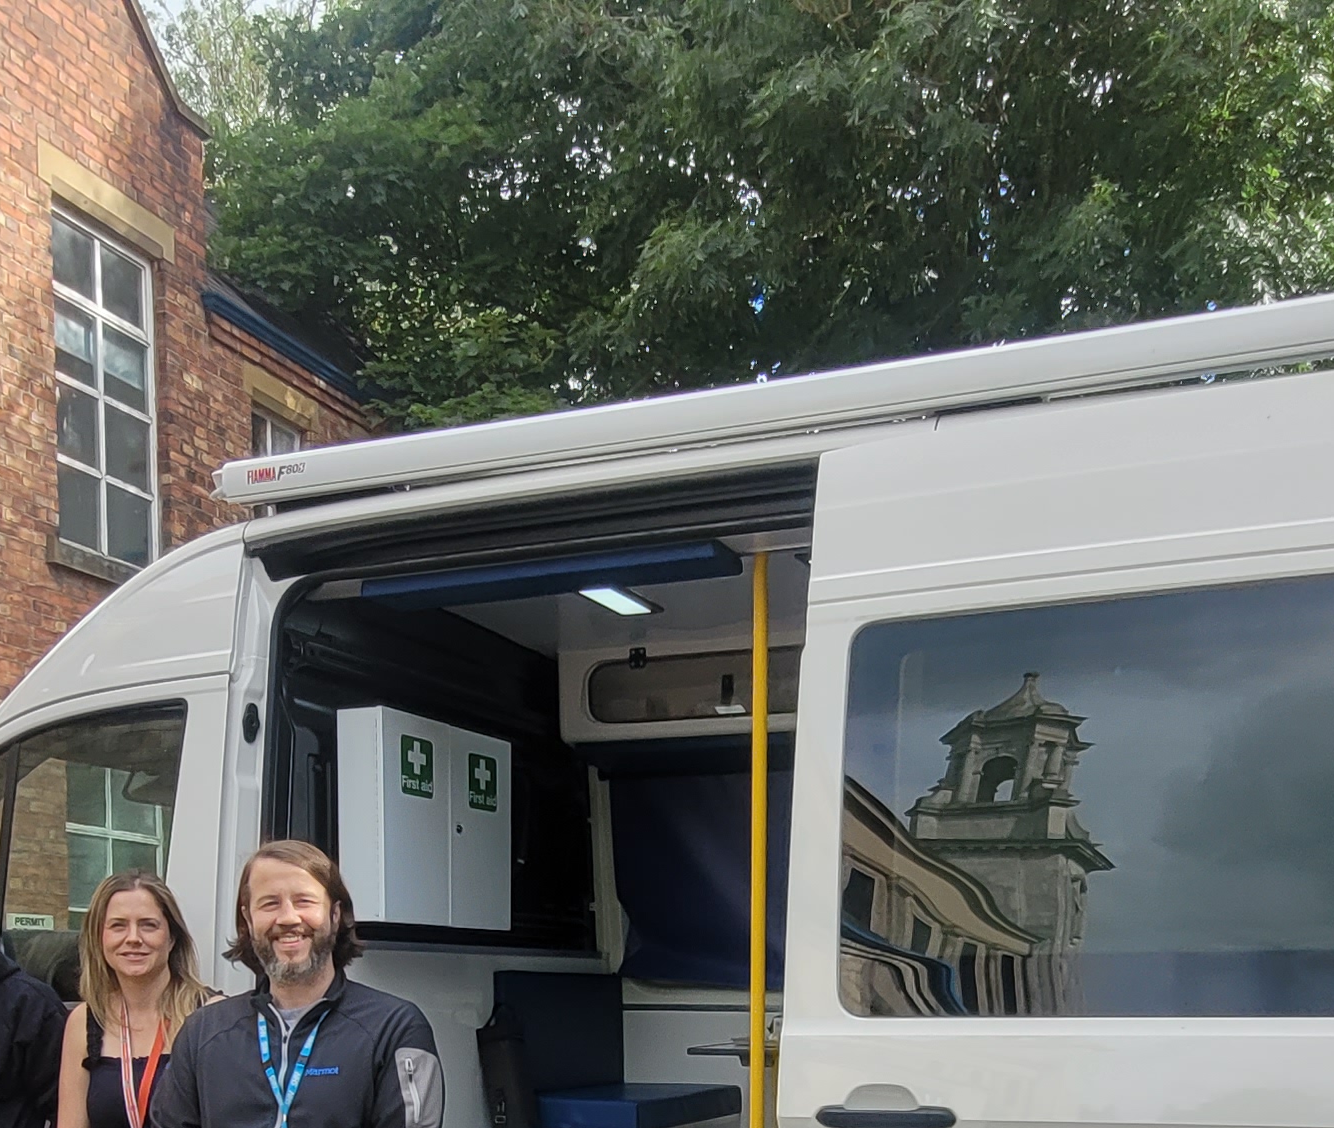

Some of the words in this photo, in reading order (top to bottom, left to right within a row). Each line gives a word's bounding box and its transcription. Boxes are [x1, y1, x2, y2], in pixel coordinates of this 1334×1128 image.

[247, 466, 276, 485] FIAMMA
[401, 774, 420, 791] First
[420, 780, 433, 794] aid
[469, 790, 485, 805] First
[486, 795, 497, 807] aid
[14, 916, 46, 927] PERMIT
